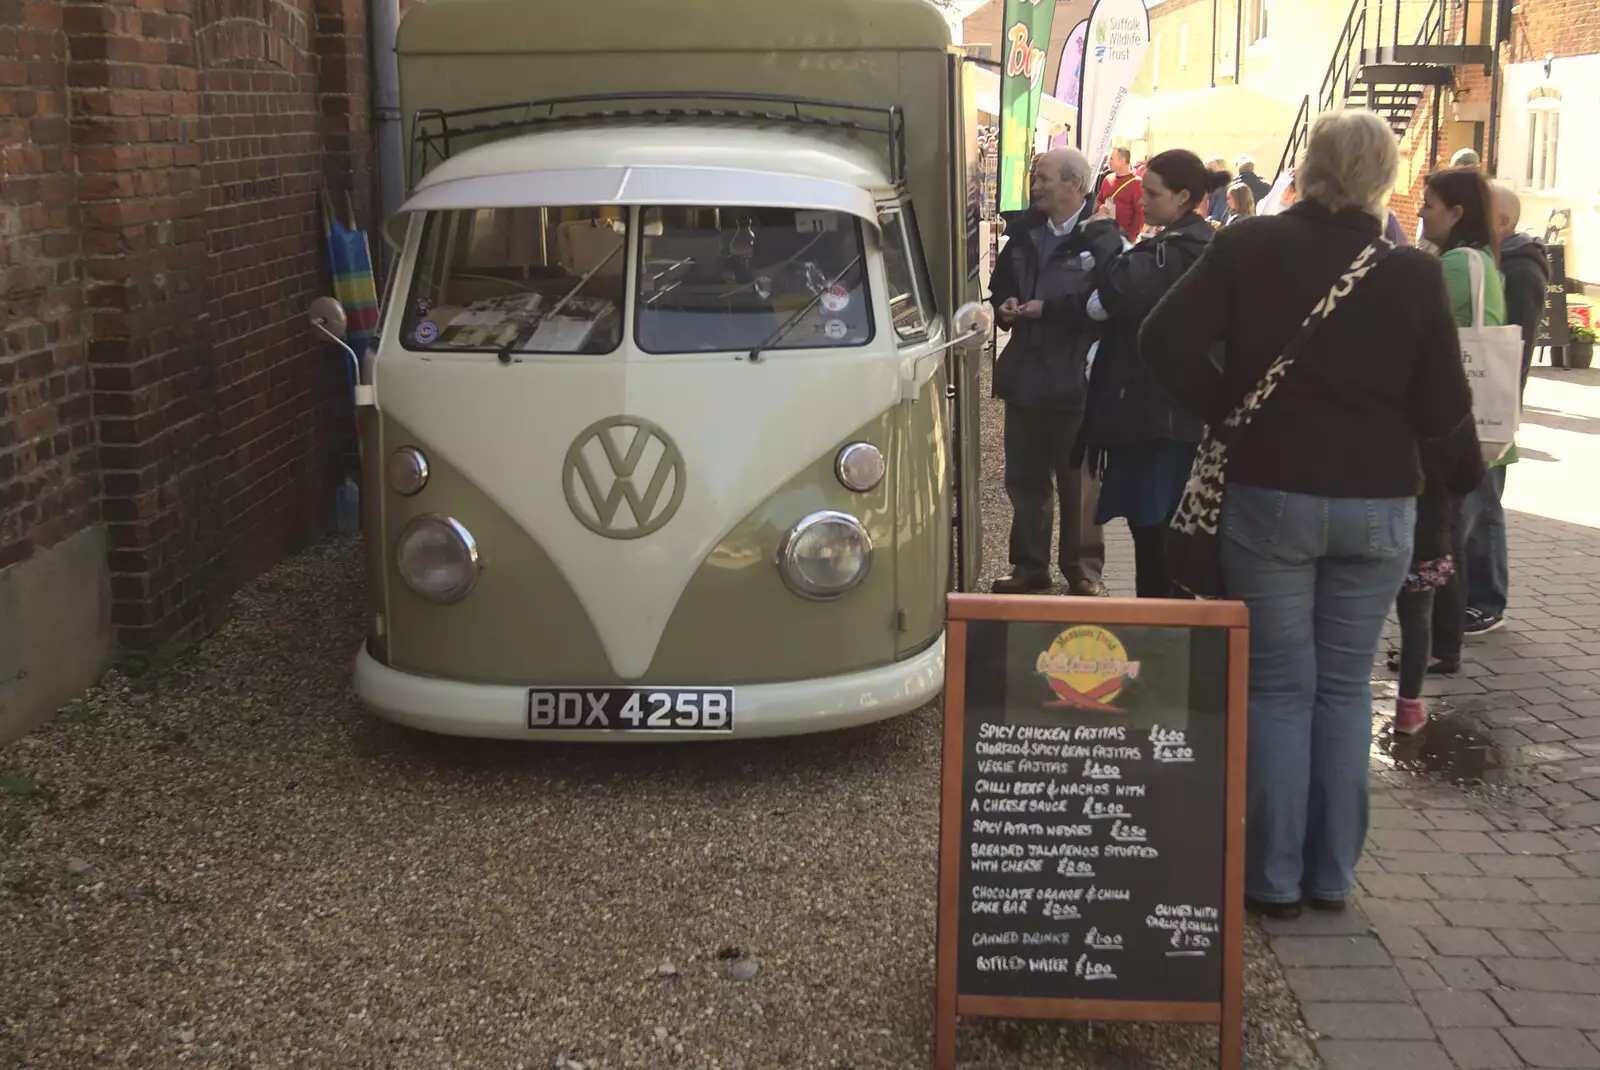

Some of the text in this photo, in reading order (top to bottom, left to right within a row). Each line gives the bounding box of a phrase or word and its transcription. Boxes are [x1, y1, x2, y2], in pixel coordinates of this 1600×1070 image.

[1109, 18, 1141, 31] Suffolk
[1109, 34, 1141, 46] Wildlife
[1109, 47, 1130, 60] Trust
[531, 692, 729, 726] BDX 425B
[979, 722, 1015, 739] SPICY
[1017, 726, 1071, 742] CHICKEN
[1074, 725, 1126, 740] FAJITAS
[1031, 742, 1060, 756] SPICY
[1061, 744, 1090, 758] BEAN
[1092, 744, 1142, 760] FAJITAS
[977, 759, 1015, 774] VEGGIE
[1018, 758, 1068, 774] FAJITAS
[975, 779, 1011, 794] CHILLI
[1013, 781, 1046, 796] BEEF
[1060, 782, 1110, 796] NACHOS
[1115, 784, 1146, 797] WITH
[970, 797, 980, 812] A
[983, 798, 1028, 812] CHEESE
[1028, 800, 1068, 812] SAUCE
[972, 819, 1002, 835] SPICY
[1004, 821, 1044, 836] POTATO
[971, 842, 1159, 858] BREADED JALAPENOS STUFFED
[971, 860, 999, 872] WITH
[1001, 859, 1044, 873] CHEESE
[972, 885, 1034, 900] CHOCOLATE
[1036, 888, 1084, 901] ORANGE
[1097, 888, 1130, 901] CHILLI
[971, 900, 1000, 914] CAKE
[1002, 900, 1027, 914] BAR
[1193, 906, 1218, 919] WITH
[1187, 920, 1219, 933] CHILLI
[972, 931, 1019, 947] CANNED
[1021, 931, 1070, 945] DRINKS
[976, 954, 1026, 971] BOTTLED
[1028, 957, 1069, 972] WATER
